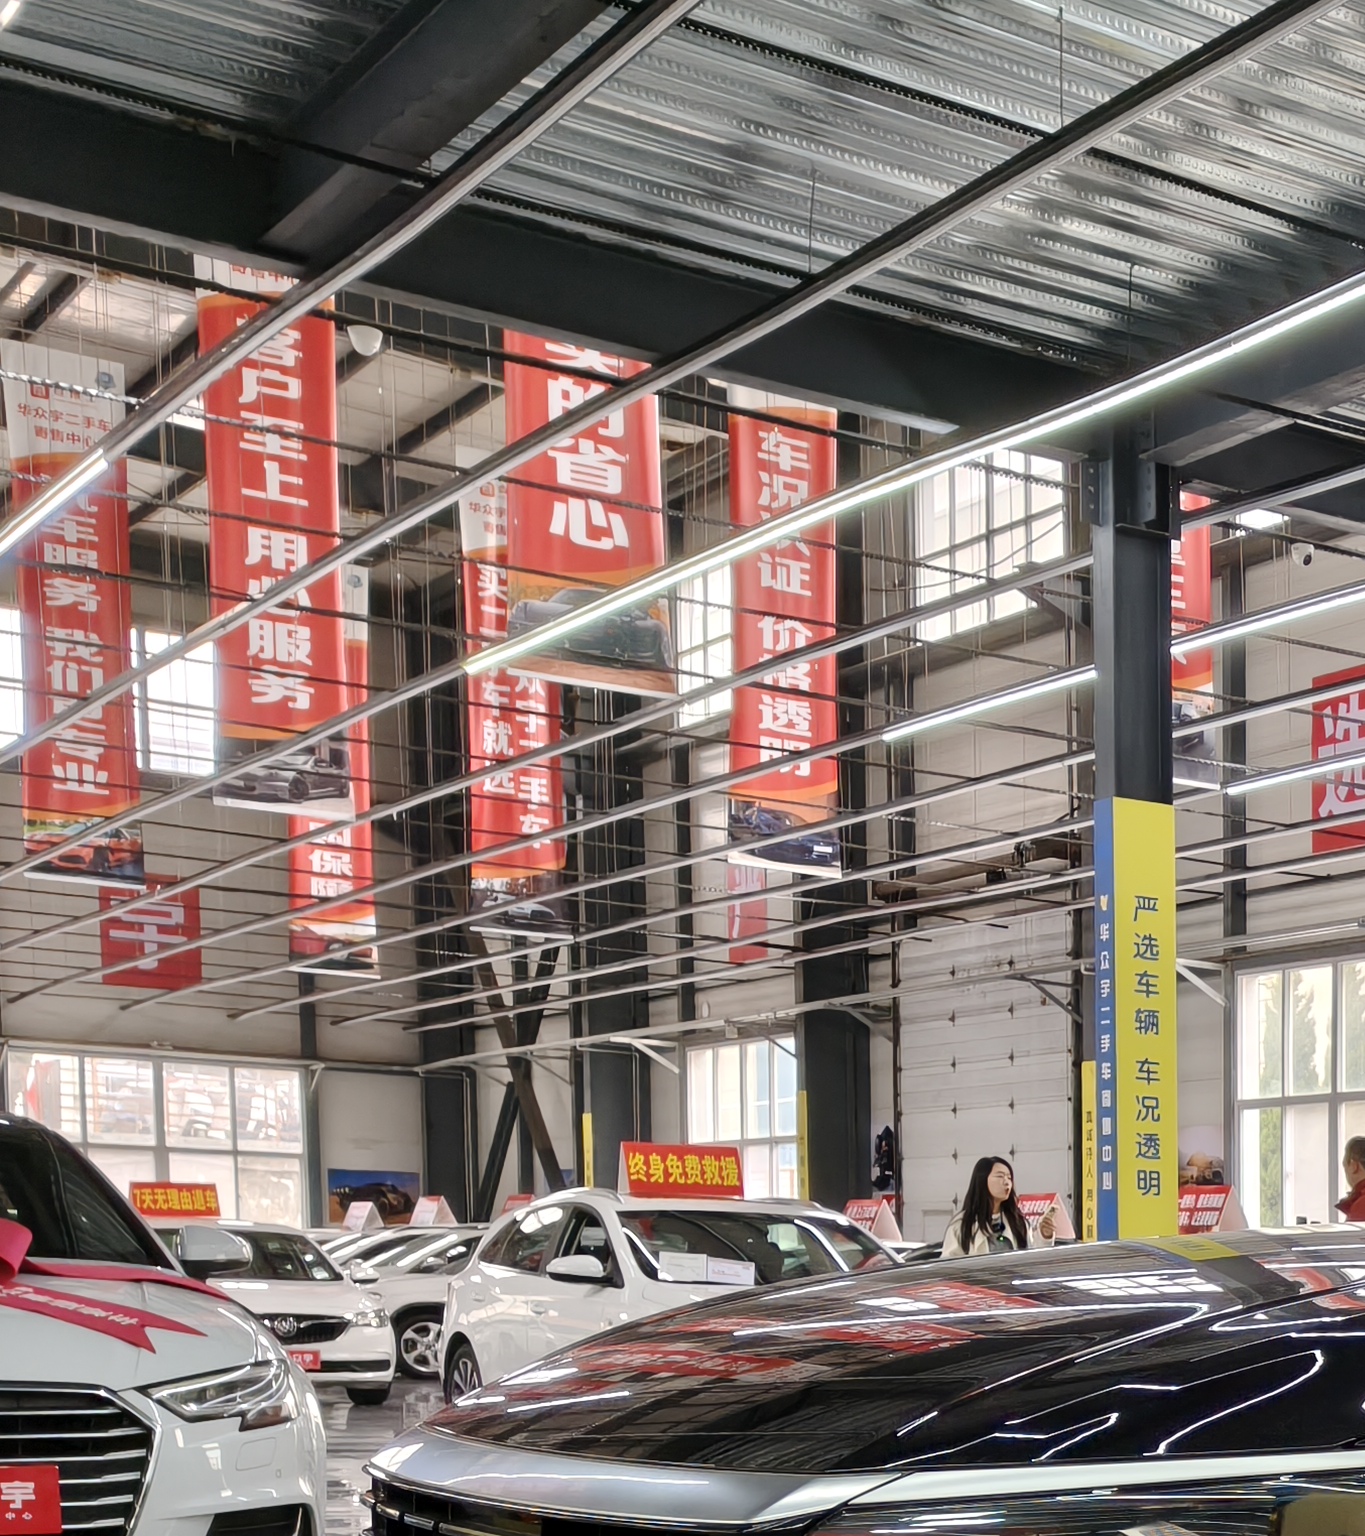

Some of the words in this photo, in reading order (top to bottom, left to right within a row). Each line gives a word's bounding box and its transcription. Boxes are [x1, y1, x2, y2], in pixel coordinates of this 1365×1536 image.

[1133, 894, 1161, 1036] 严选车辆
[628, 1151, 740, 1187] 终身免费救援
[1134, 1057, 1162, 1197] 车况透明
